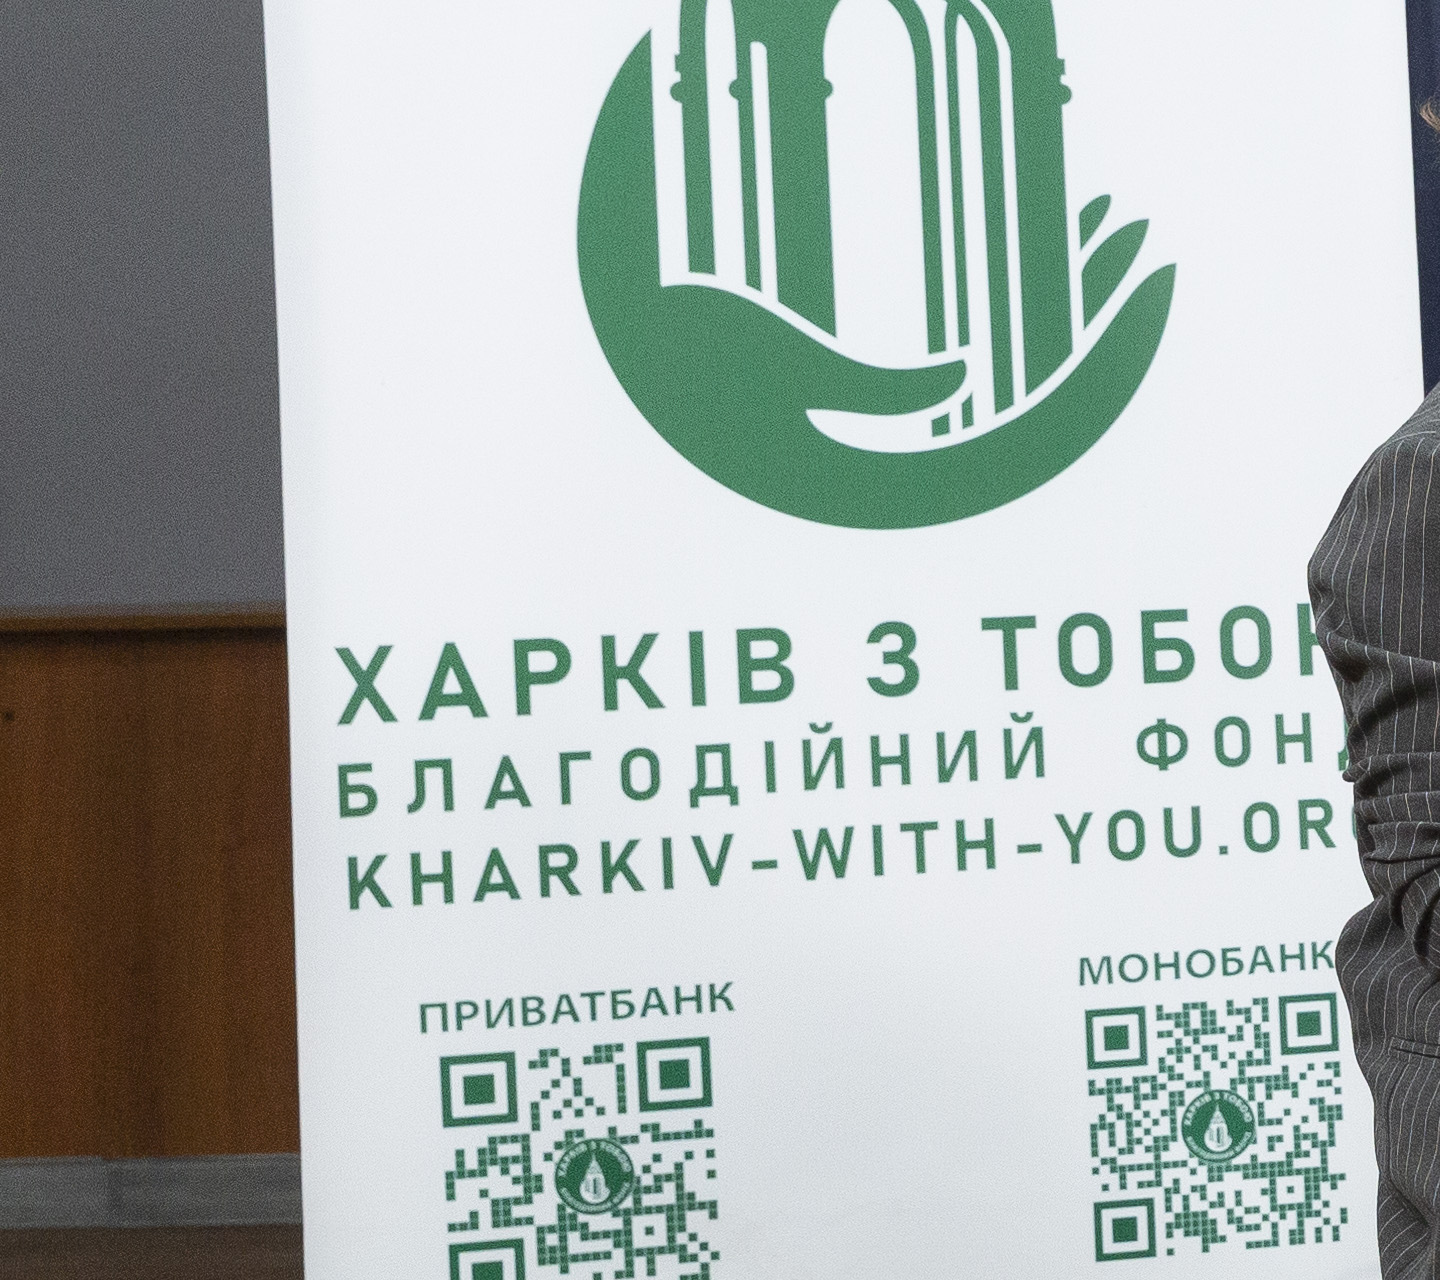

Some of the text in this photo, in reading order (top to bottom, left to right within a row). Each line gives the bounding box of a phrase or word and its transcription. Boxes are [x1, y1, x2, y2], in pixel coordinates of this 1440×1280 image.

[337, 628, 795, 724] ХАРКІВ
[868, 621, 920, 697] З
[338, 711, 1349, 818] БЛАГОДІЙНИЙ ФОН
[348, 797, 1358, 910] KHARKIV-WITH-YOU.OR
[419, 981, 735, 1034] ПРИВАТБАНК
[1078, 939, 1335, 987] МОНОБАНК
